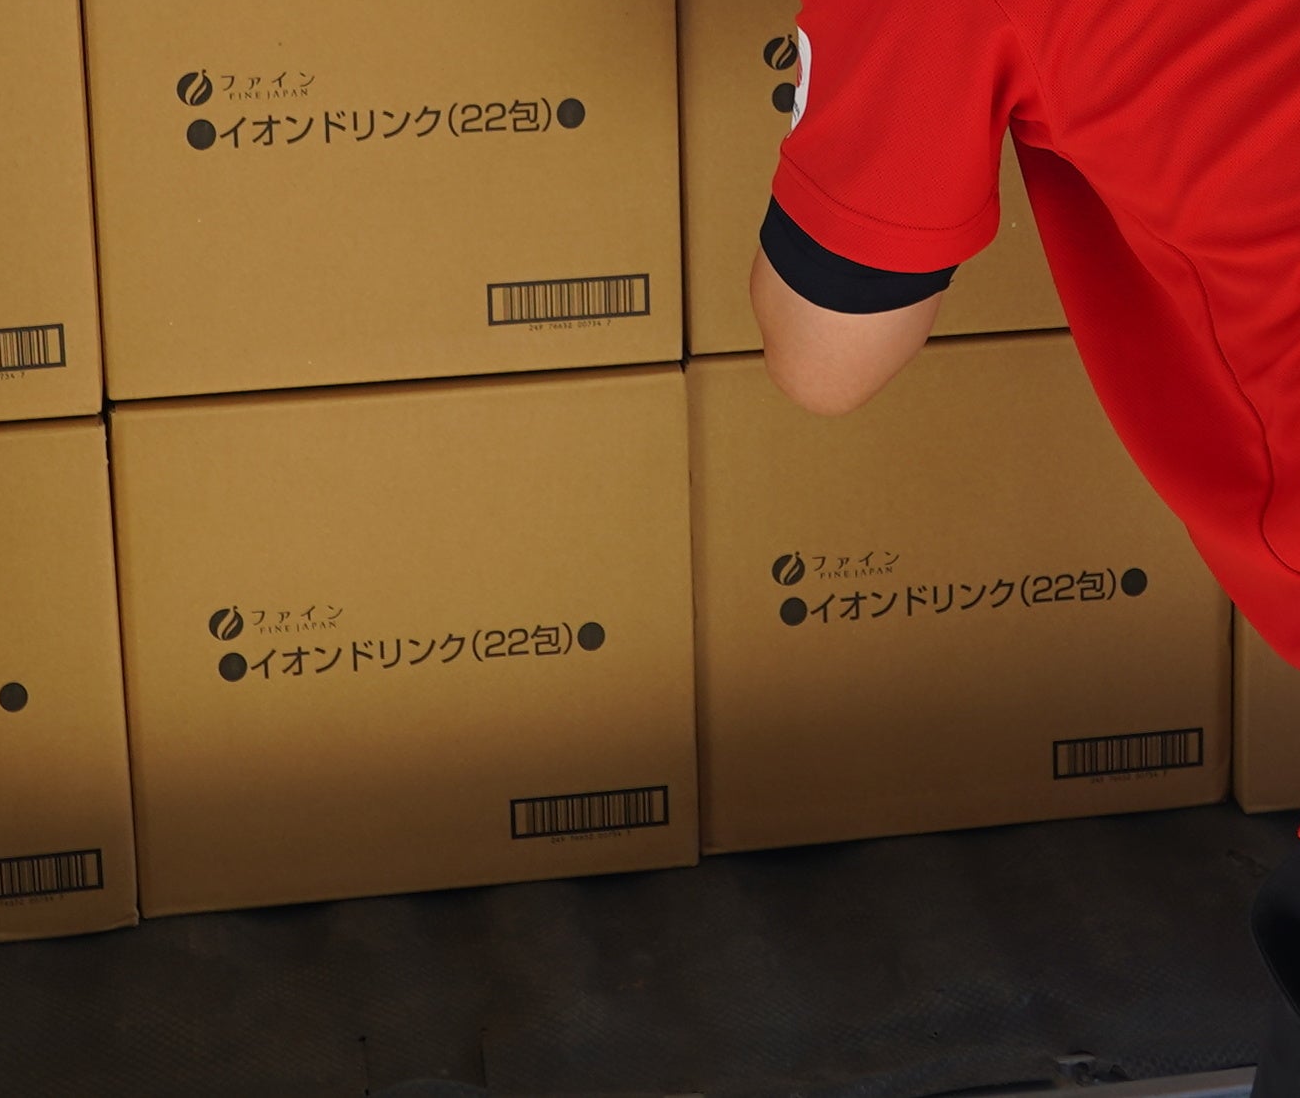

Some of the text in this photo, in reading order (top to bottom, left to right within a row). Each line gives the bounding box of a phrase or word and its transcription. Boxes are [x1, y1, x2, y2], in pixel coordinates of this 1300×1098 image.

[222, 72, 315, 91] ファイン
[812, 552, 899, 571] ファイン
[252, 605, 343, 626] ファイン
